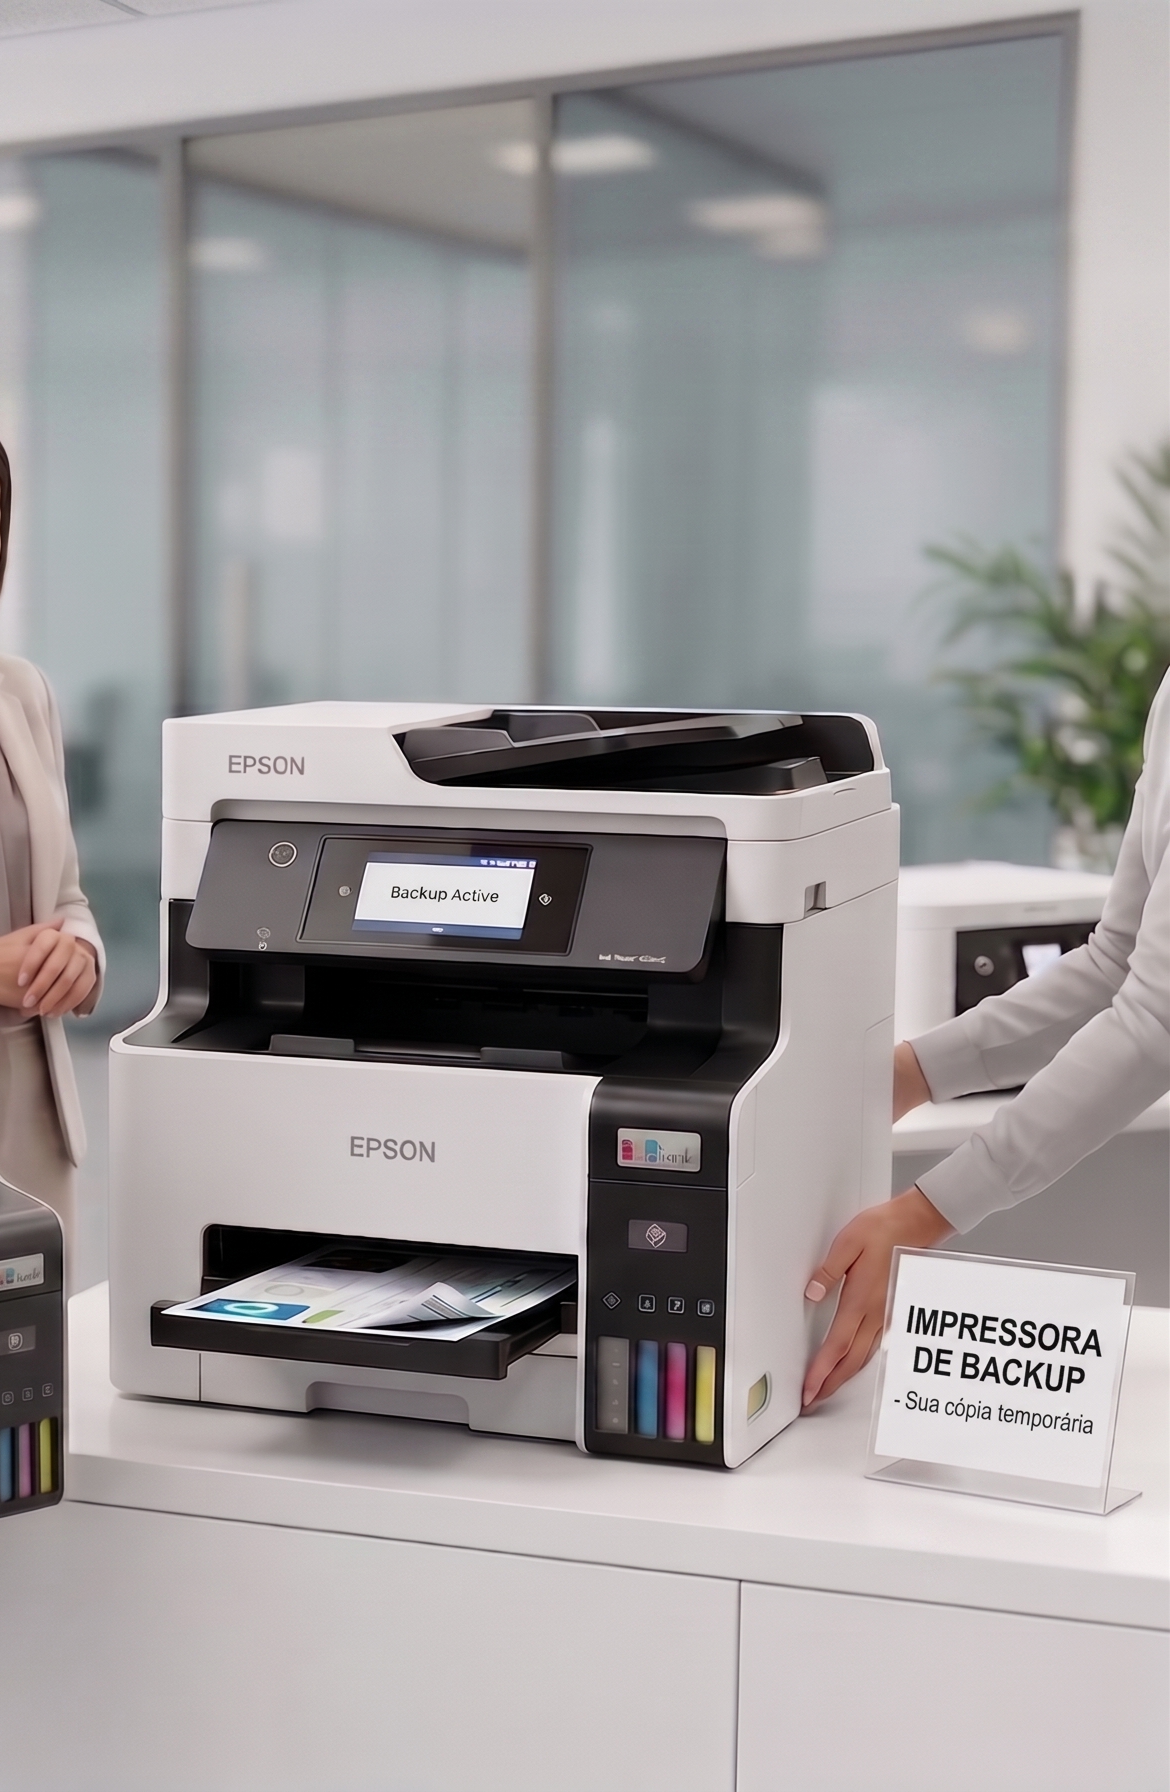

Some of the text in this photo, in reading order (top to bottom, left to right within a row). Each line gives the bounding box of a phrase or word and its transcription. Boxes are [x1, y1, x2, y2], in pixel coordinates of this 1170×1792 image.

[228, 754, 305, 776] EPSON
[390, 886, 499, 903] Backup Active
[350, 1136, 435, 1163] EPSON
[906, 1305, 1102, 1357] IMPRESSORA
[913, 1346, 1086, 1393] DE BACKUP
[905, 1390, 939, 1414] Sua
[944, 1397, 992, 1422] cópia
[998, 1403, 1094, 1435] temporária
